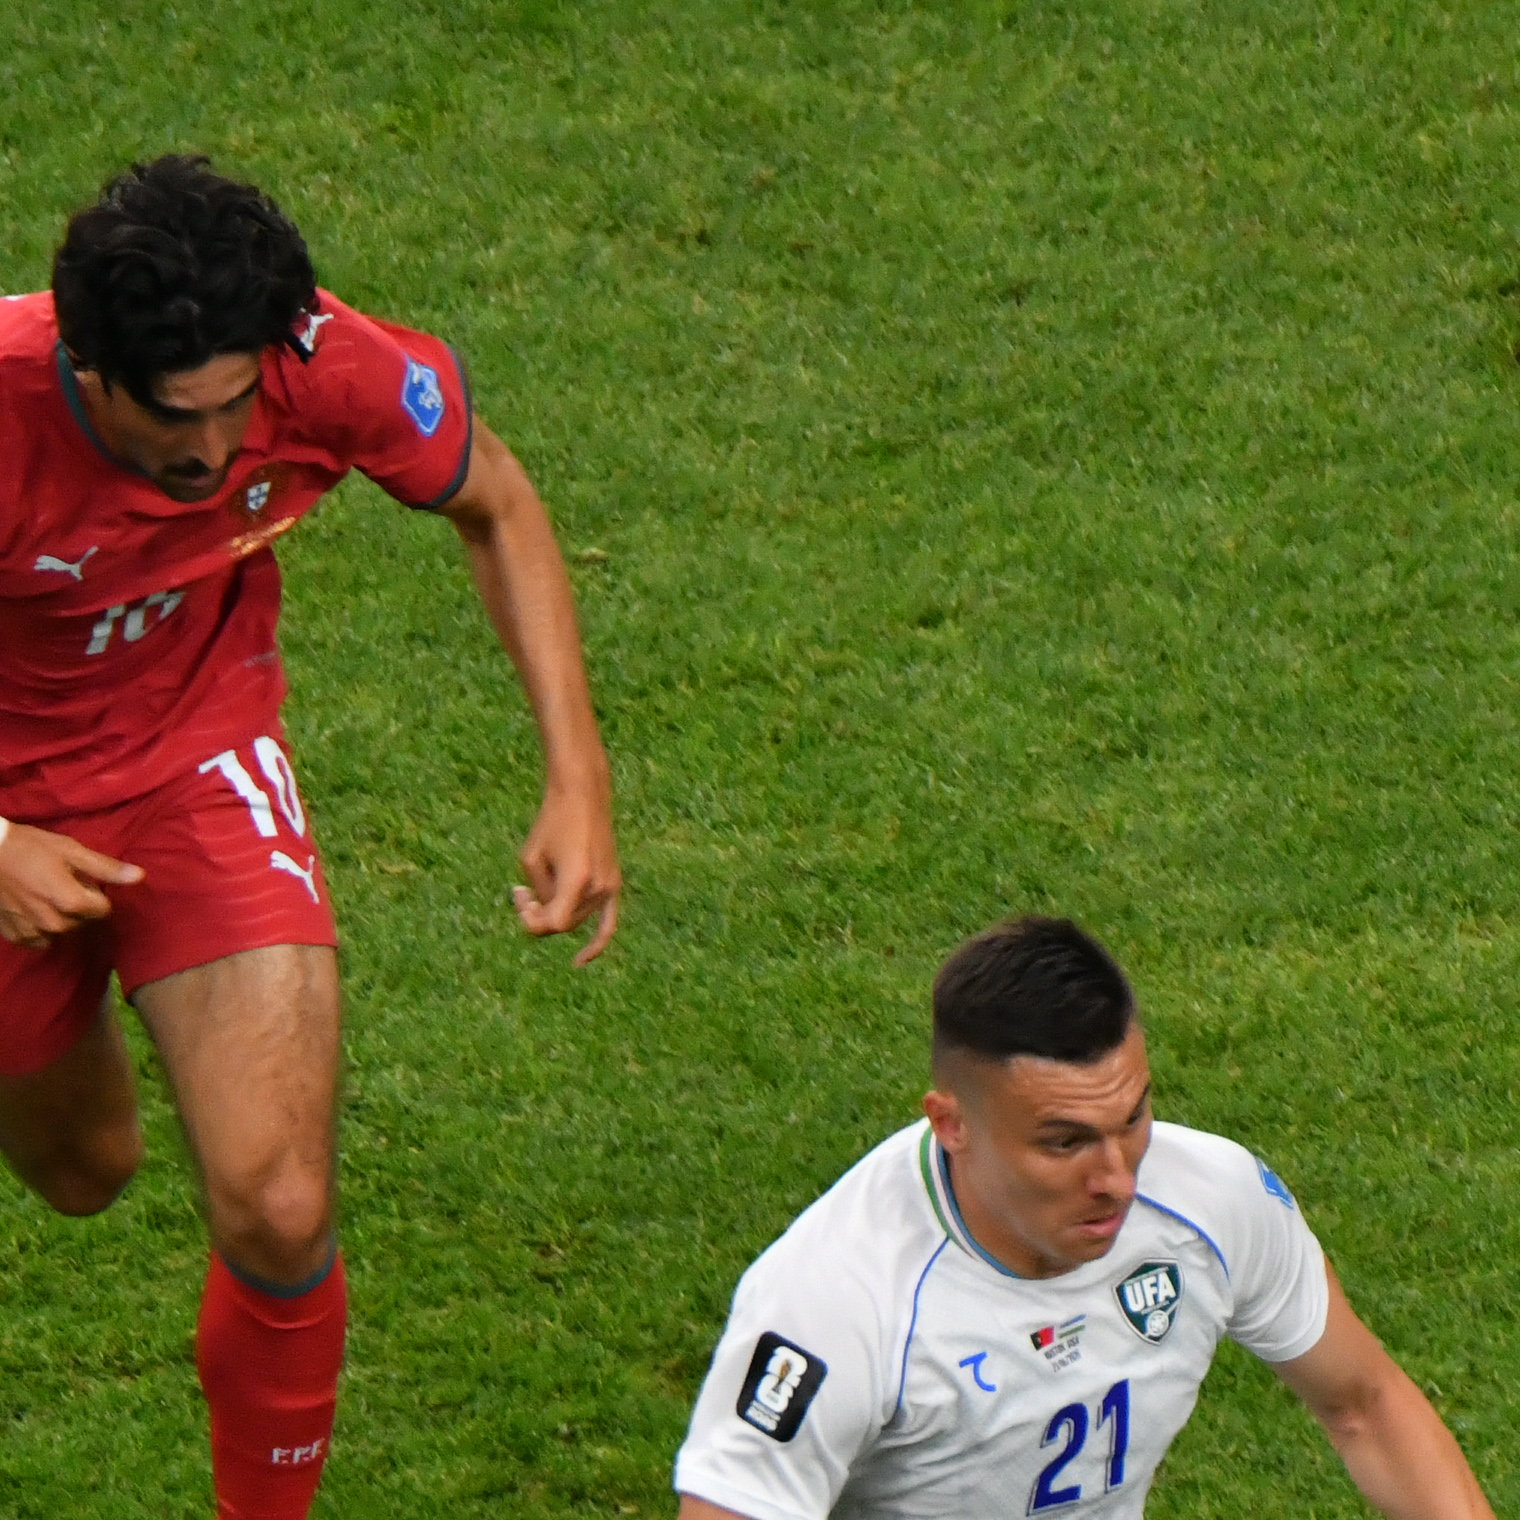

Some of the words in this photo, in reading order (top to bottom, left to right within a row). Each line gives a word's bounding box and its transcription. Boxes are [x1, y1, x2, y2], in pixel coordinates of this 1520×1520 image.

[197, 735, 305, 838] 10
[1125, 1271, 1177, 1312] UFA
[1026, 1377, 1130, 1517] 21
